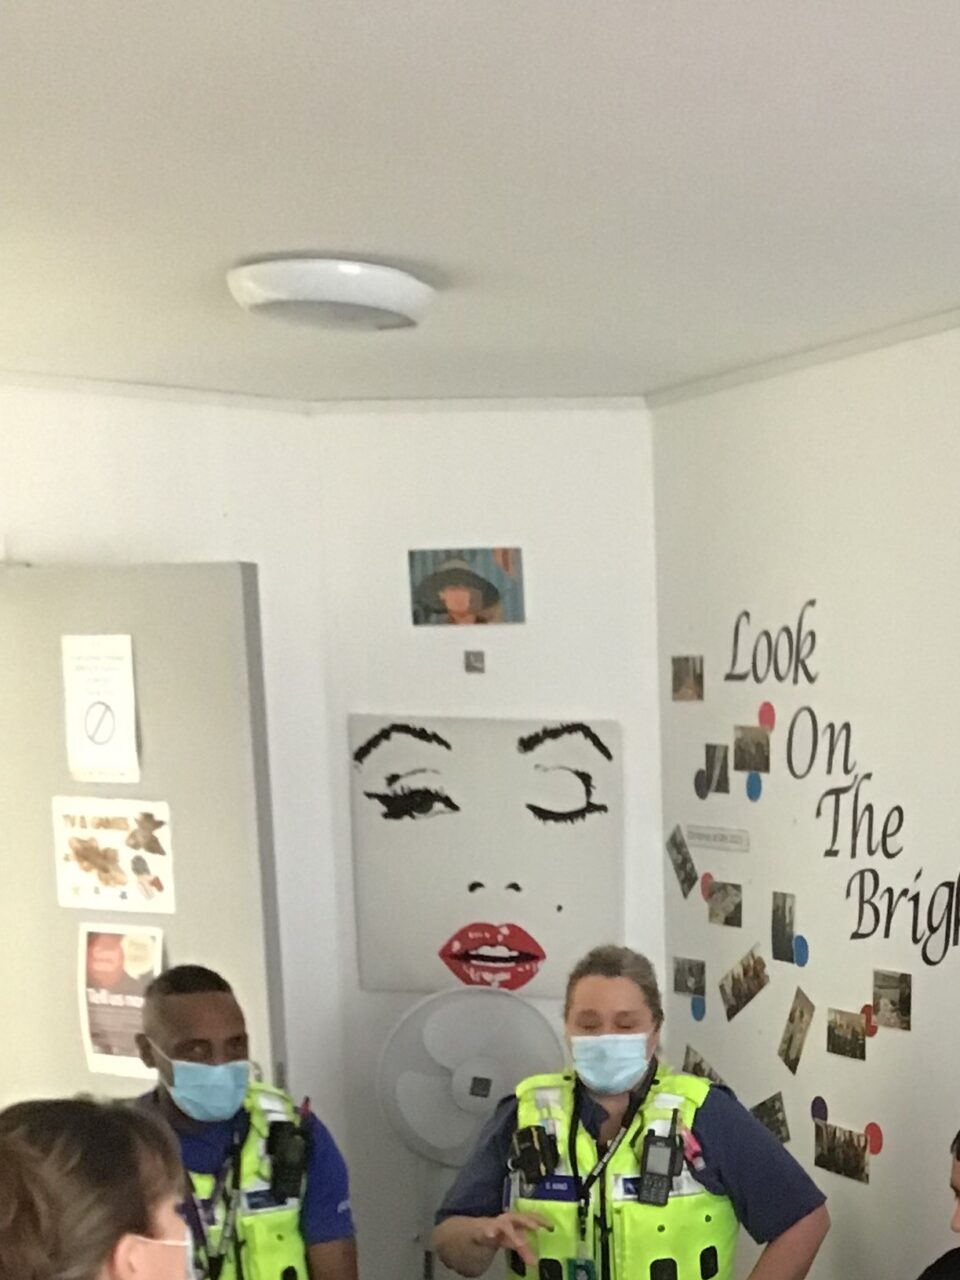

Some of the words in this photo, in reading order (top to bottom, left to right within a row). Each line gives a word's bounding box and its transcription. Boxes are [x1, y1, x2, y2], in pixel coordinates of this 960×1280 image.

[724, 599, 818, 685] Look
[787, 706, 856, 779] On
[816, 772, 904, 859] The
